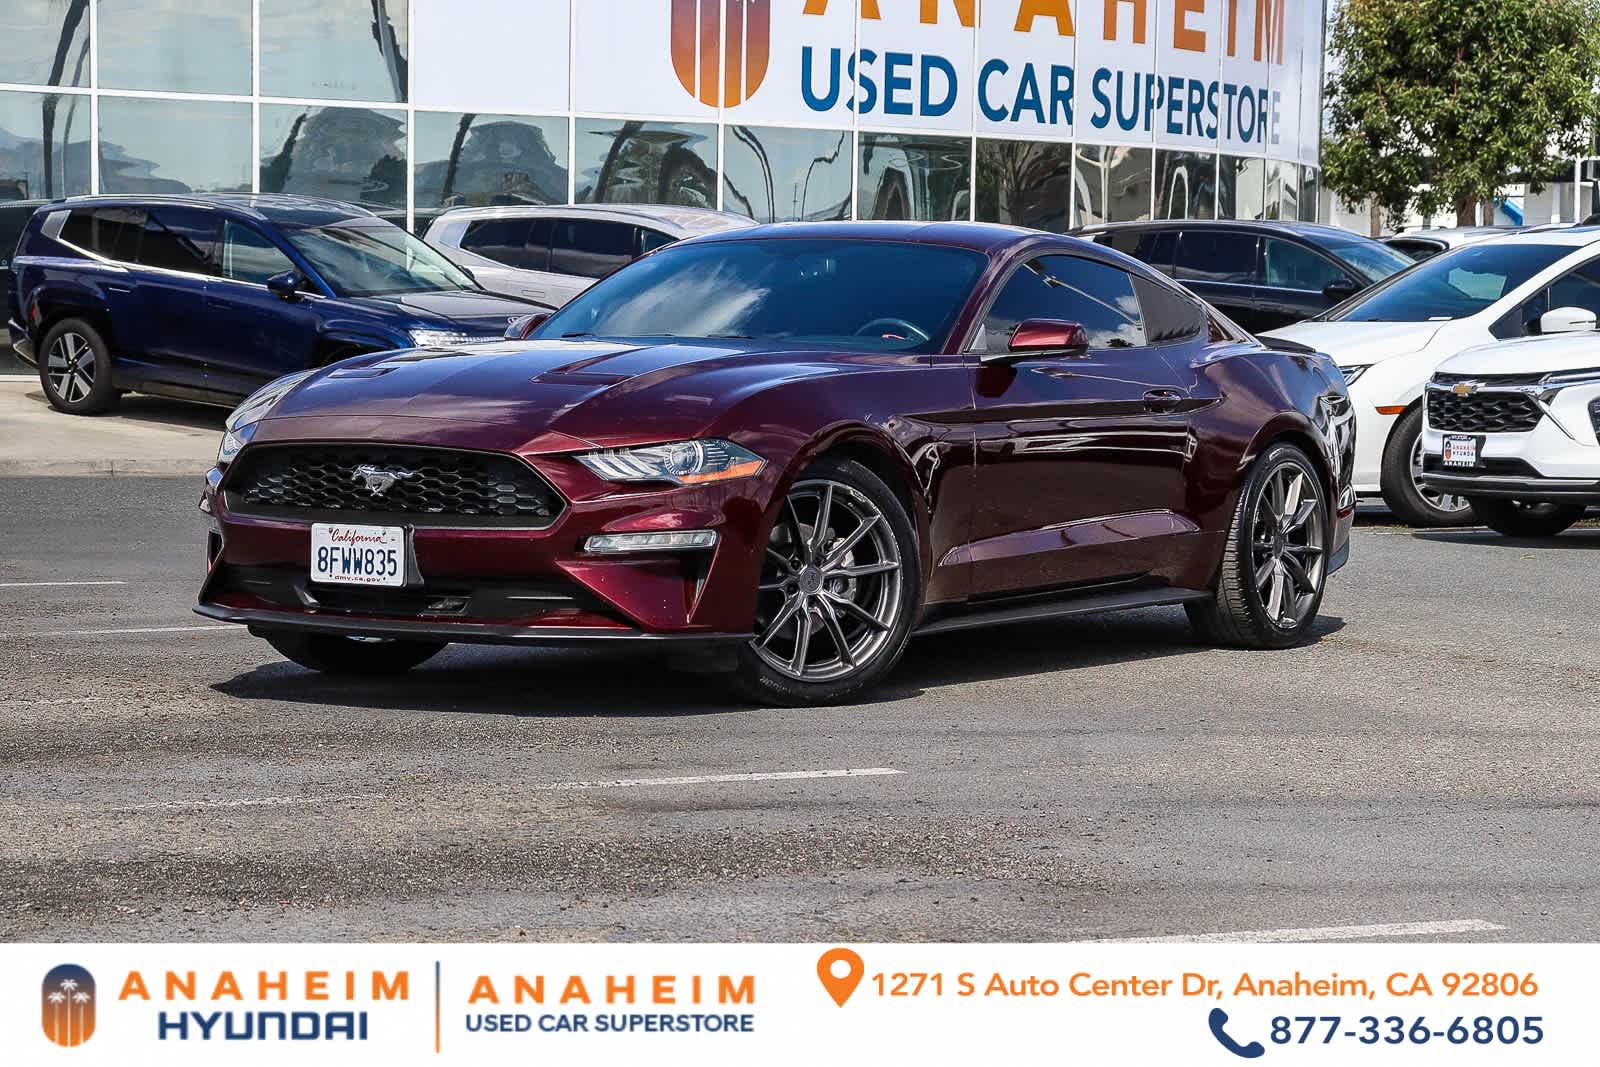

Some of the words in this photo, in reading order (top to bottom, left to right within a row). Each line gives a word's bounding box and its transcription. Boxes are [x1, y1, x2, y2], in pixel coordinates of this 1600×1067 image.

[801, 46, 958, 117] USED
[978, 58, 1074, 126] CAR
[1090, 67, 1281, 145] SUPERSTORE
[331, 528, 387, 546] California
[317, 546, 398, 577] 8FWW835
[334, 575, 381, 583] dmv.ca.gov
